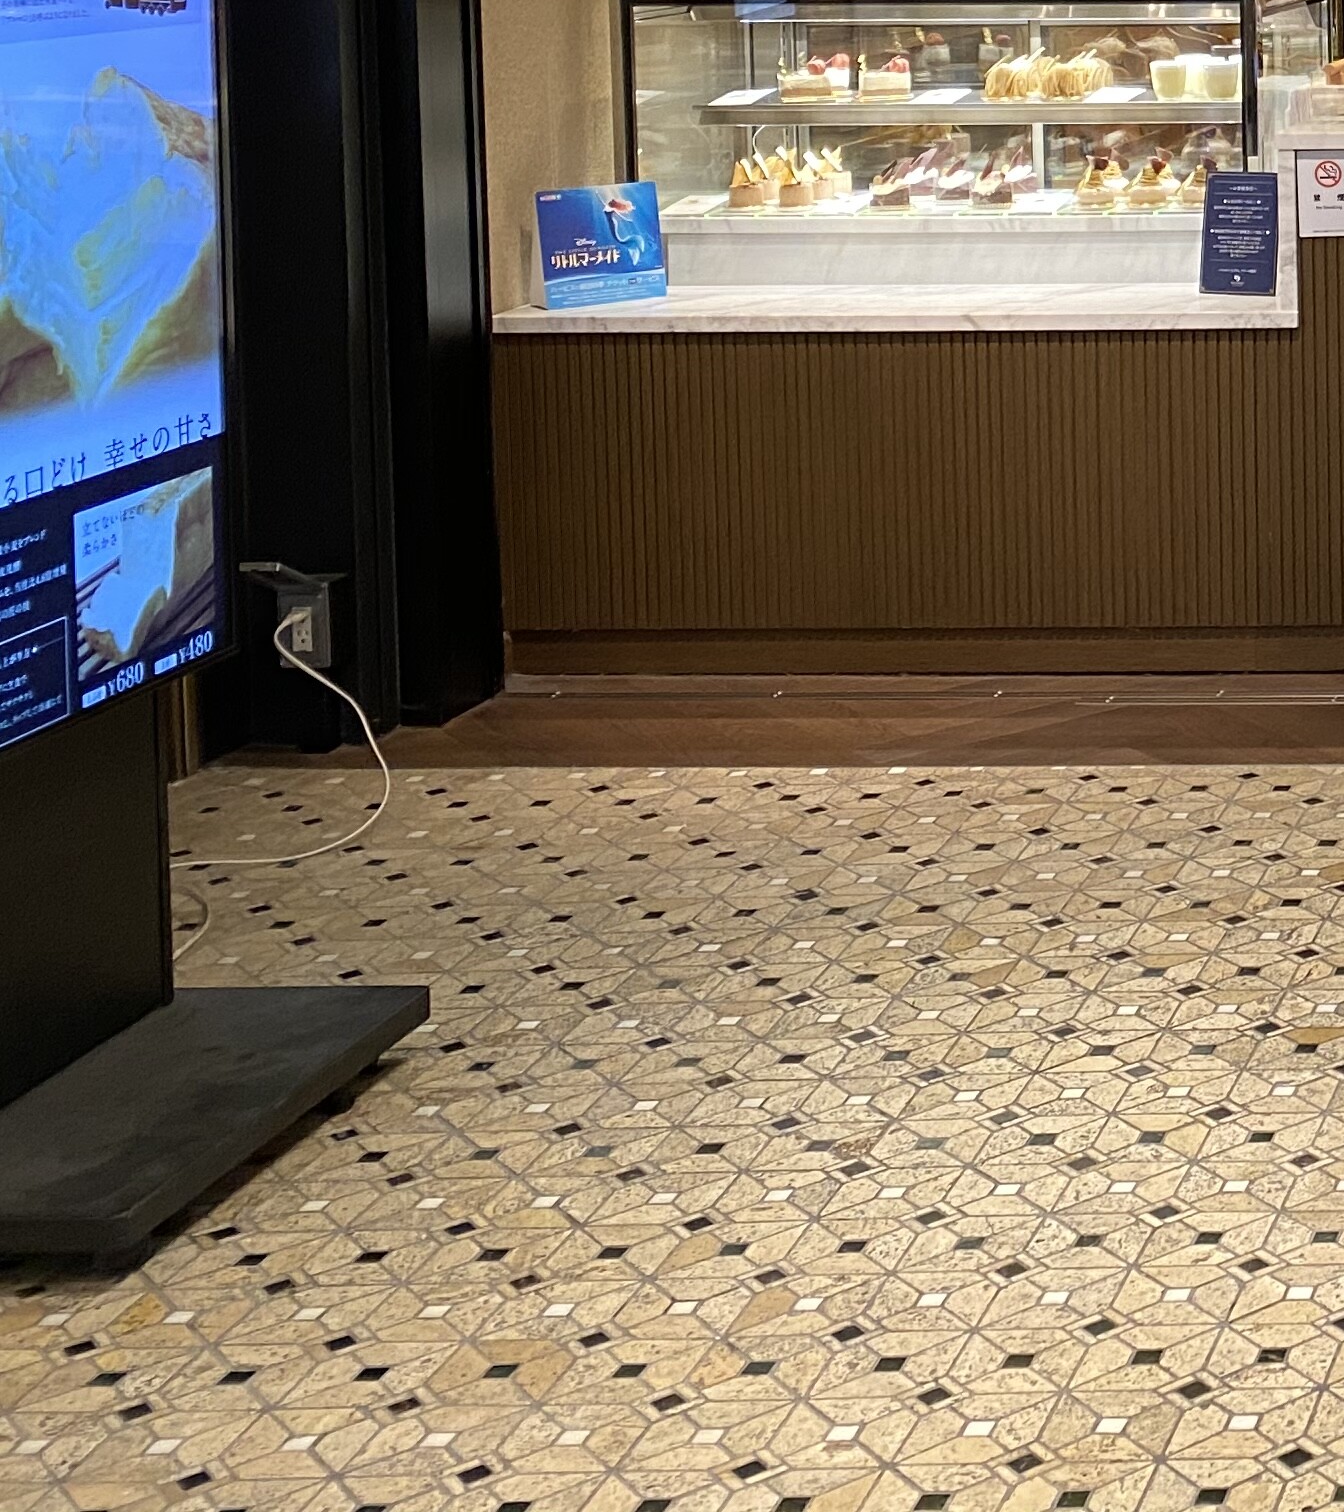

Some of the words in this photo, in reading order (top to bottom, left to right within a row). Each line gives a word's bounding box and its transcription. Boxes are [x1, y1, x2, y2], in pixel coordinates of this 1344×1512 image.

[550, 248, 621, 270] リトルマーメイド
[104, 412, 212, 470] 幸せの甘さ
